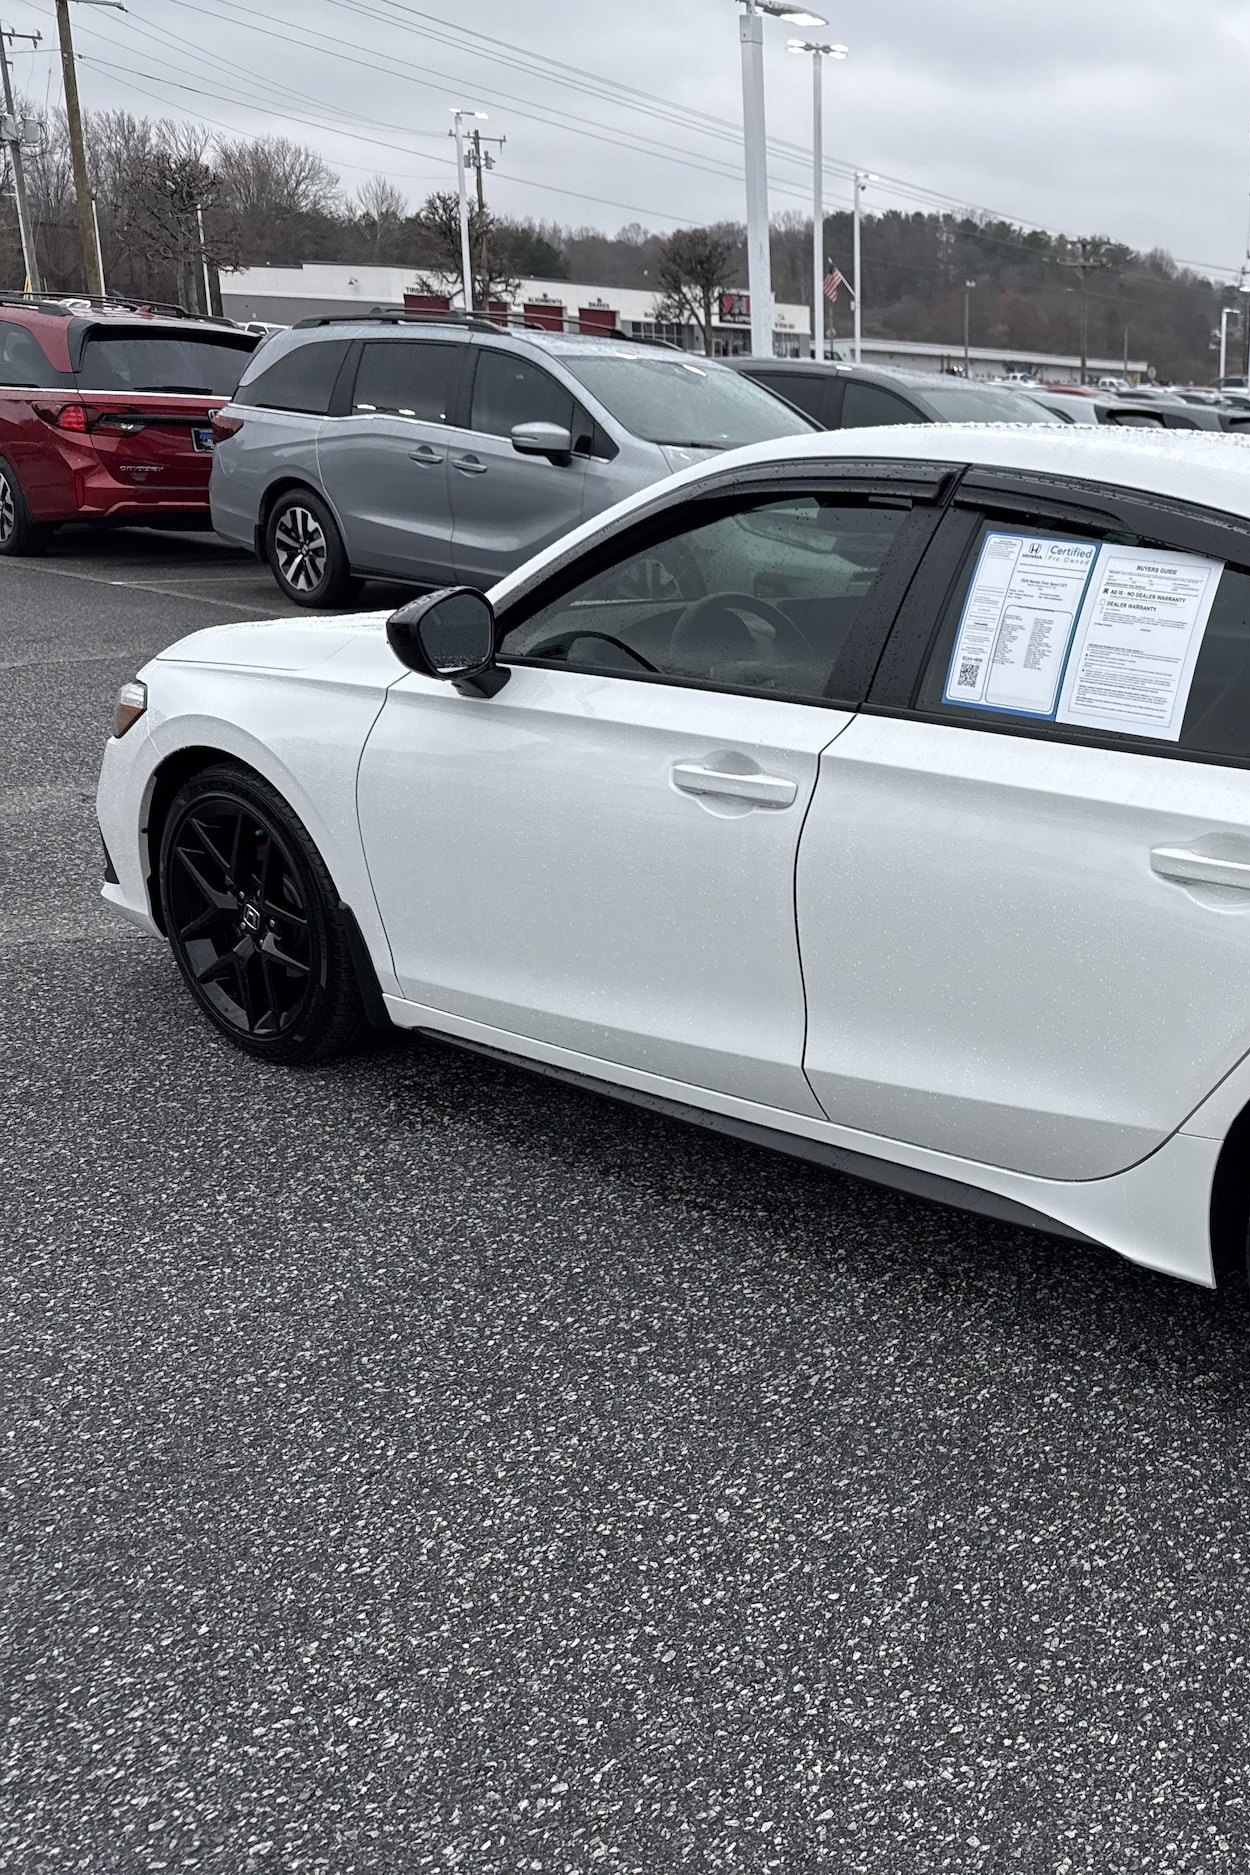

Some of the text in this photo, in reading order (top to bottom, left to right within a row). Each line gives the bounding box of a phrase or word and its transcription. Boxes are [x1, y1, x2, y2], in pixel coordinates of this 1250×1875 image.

[1050, 545, 1093, 559] Certified
[1136, 565, 1178, 575] BUYERS GUIDE
[1135, 592, 1156, 600] DEALER
[1157, 595, 1186, 603] WARRANTY
[1106, 601, 1157, 612] DEALER WARRANTY
